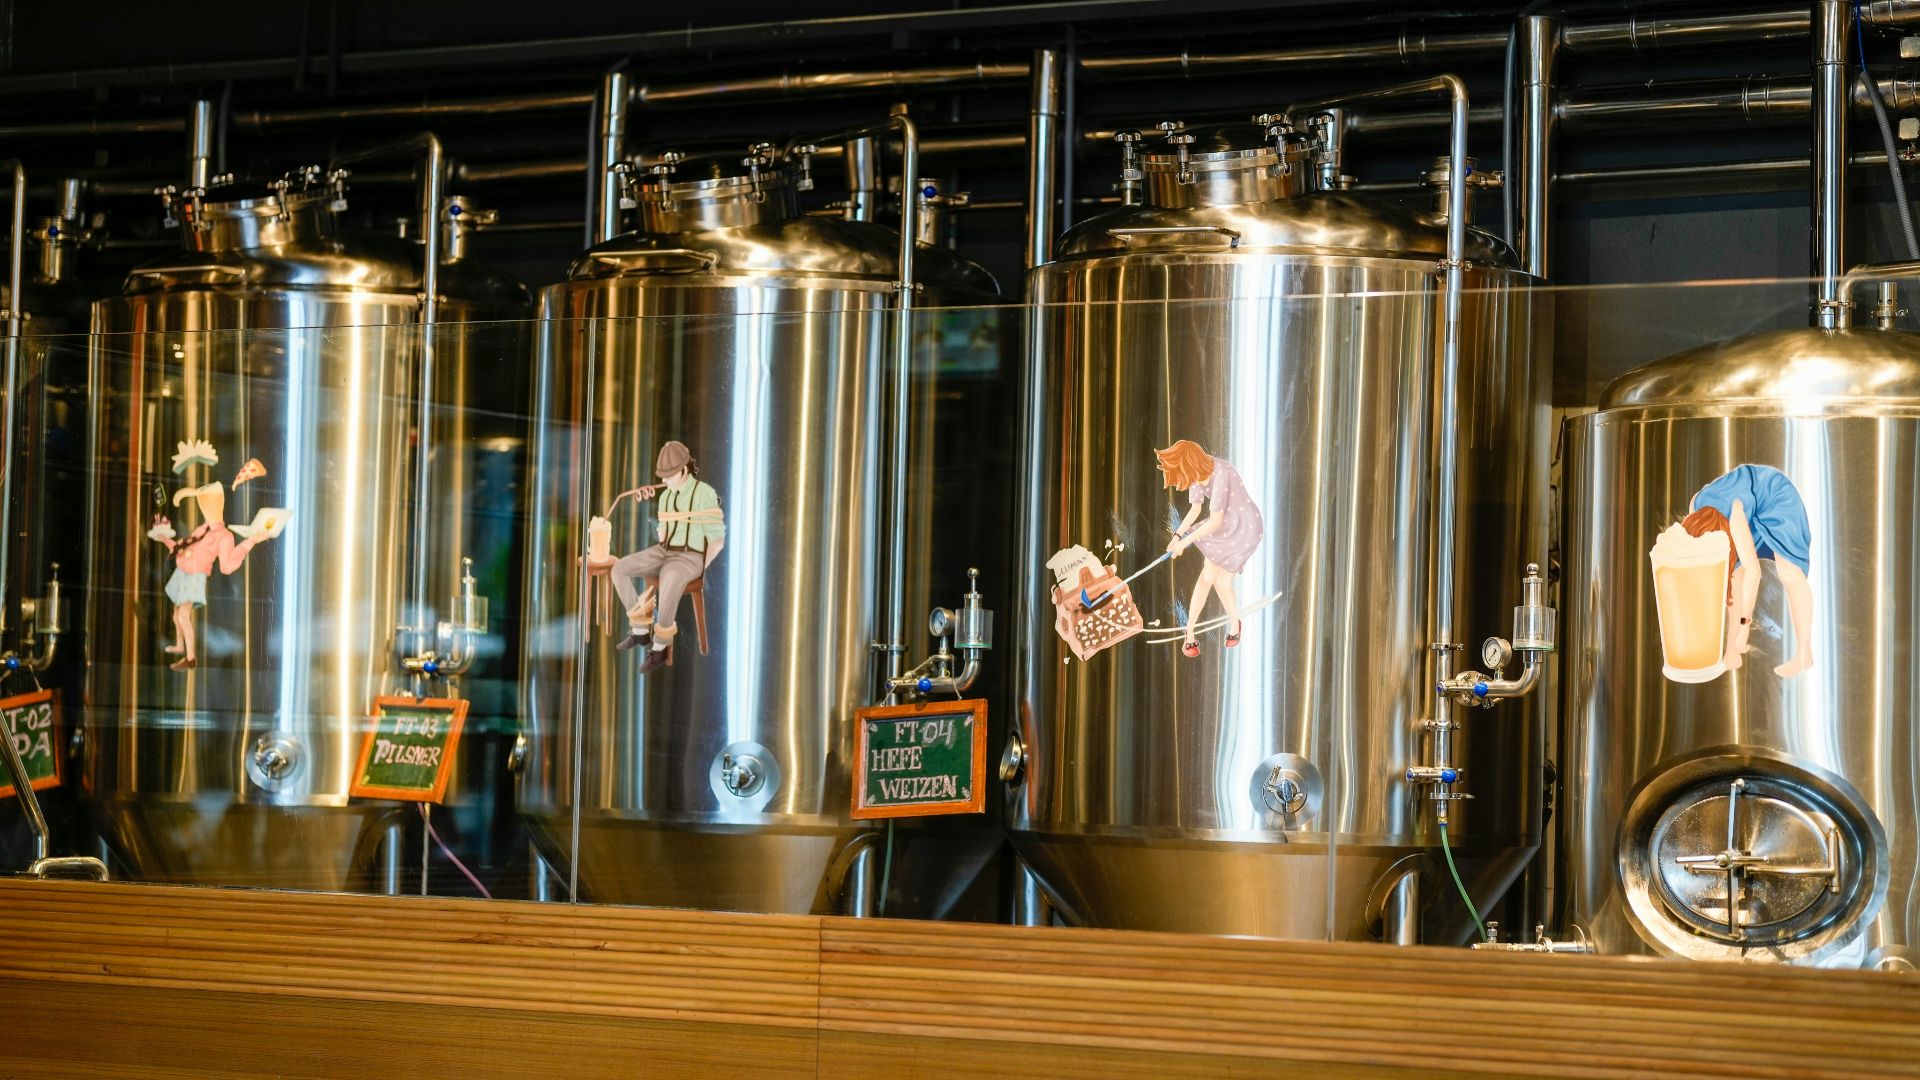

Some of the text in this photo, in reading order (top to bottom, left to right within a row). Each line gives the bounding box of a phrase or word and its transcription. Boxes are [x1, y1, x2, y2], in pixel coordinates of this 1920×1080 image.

[373, 739, 441, 767] PILSNER
[871, 746, 922, 772] HEFE
[879, 774, 959, 800] WEIZEN
